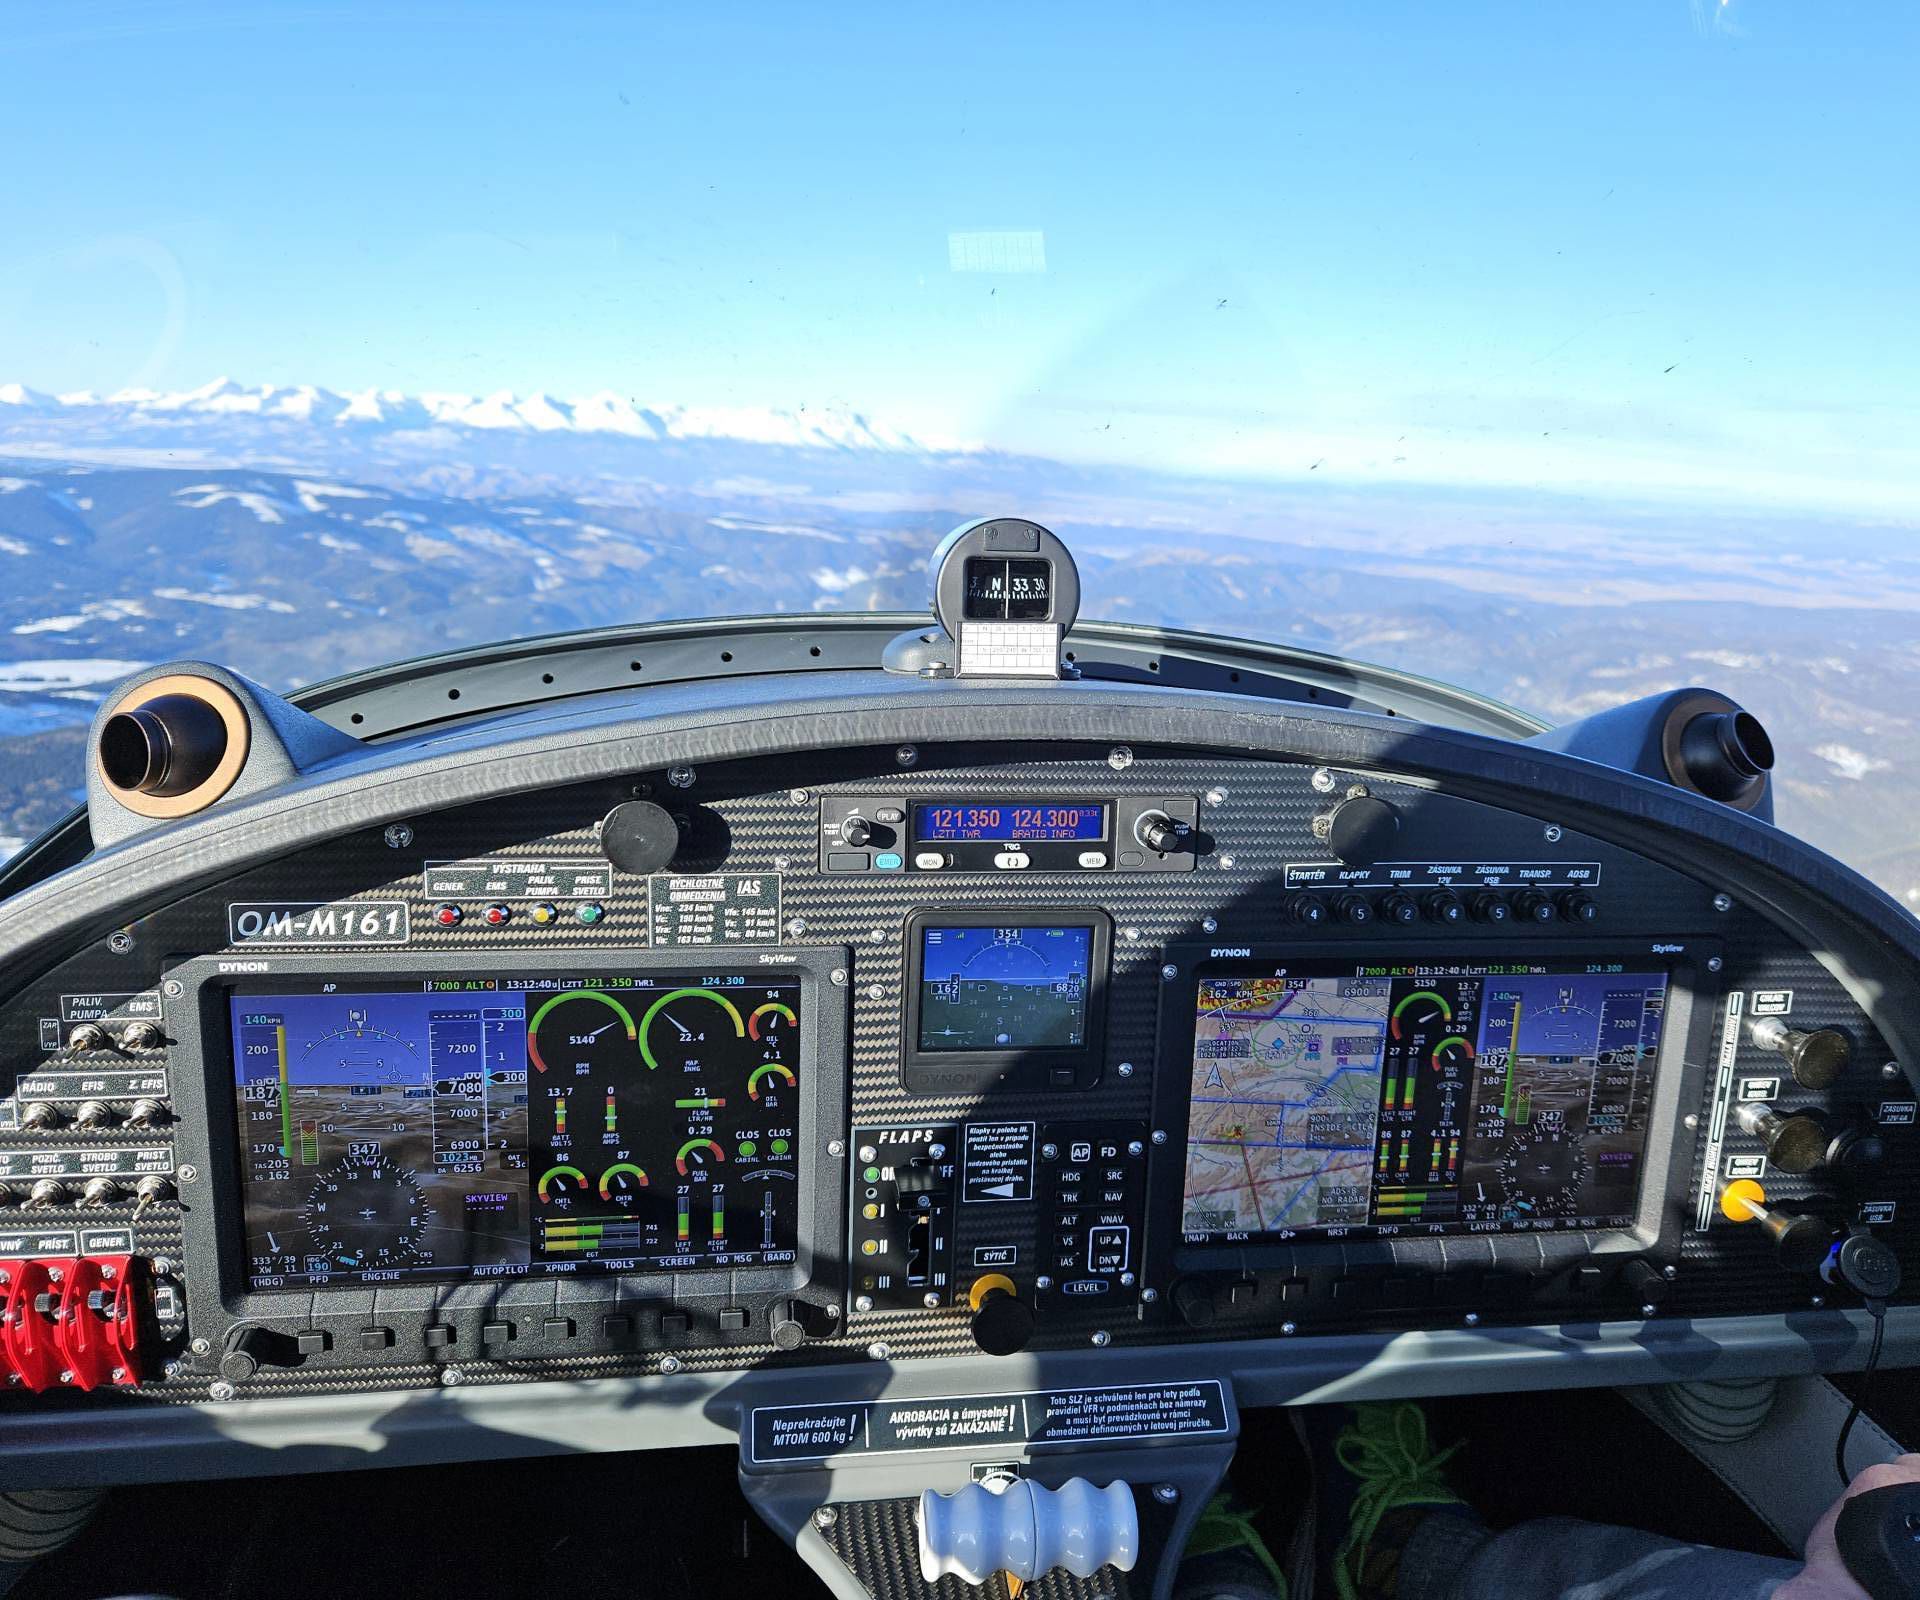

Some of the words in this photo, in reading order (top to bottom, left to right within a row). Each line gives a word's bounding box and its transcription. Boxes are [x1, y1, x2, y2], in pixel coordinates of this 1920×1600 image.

[992, 578, 1001, 590] N
[1013, 579, 1029, 591] 33
[1033, 578, 1045, 591] 30
[881, 813, 899, 821] PLAY
[932, 809, 1000, 827] 121.350
[1012, 809, 1079, 827] 124.300
[932, 830, 957, 839] LZTT
[960, 830, 981, 839] TWR
[1012, 830, 1047, 839] BRATIS
[1051, 830, 1076, 838] INFO
[493, 863, 545, 873] VÝSTRAHA
[1427, 864, 1462, 874] ZÁSUVKA
[1475, 864, 1510, 874] ZÁSUVKA
[1289, 869, 1326, 881] ŠTARTÉR
[1339, 870, 1371, 879] KLAPKY
[1390, 870, 1412, 878] TRIM
[1519, 870, 1552, 878] TRANSP.
[1567, 870, 1590, 878] ADSB
[528, 876, 553, 884] PALIV.
[670, 877, 724, 888] RÝCHLOSTNÉ
[1438, 876, 1452, 884] 12V
[1484, 876, 1500, 884] USB
[433, 882, 465, 891] GENER.
[485, 882, 507, 890] EMS
[525, 887, 558, 896] PUMPA
[572, 887, 605, 896] SVETLO
[737, 880, 761, 894] IAS
[679, 904, 693, 912] 234
[1450, 908, 1457, 918] 4
[1496, 908, 1503, 918] 5
[1542, 908, 1548, 918] 3
[1310, 909, 1318, 919] 4
[1357, 909, 1365, 919] 5
[1404, 909, 1411, 919] 2
[237, 911, 399, 936] OM-M161
[998, 929, 1018, 939] 354
[1210, 949, 1250, 957] DYNON
[1652, 944, 1684, 953] SkyView
[759, 955, 797, 965] SkyView
[219, 962, 268, 972] DYNON
[1365, 967, 1386, 975] 7000
[1488, 966, 1528, 974] 121.350
[1586, 964, 1622, 973] 124.300
[434, 982, 460, 990] 7000
[466, 981, 485, 990] ALT
[583, 978, 632, 988] 121.350
[702, 977, 745, 986] 124.300
[1288, 980, 1304, 988] 354
[323, 984, 336, 992] AP
[72, 997, 102, 1007] PALIV.
[129, 1002, 153, 1012] EMS
[70, 1010, 108, 1019] PUMPA
[245, 1015, 267, 1024] 140
[569, 1036, 595, 1044] 5140
[680, 1033, 705, 1042] 22.4
[246, 1046, 268, 1055] 200
[447, 1045, 477, 1053] 7200
[763, 1051, 781, 1059] 4.1
[22, 1081, 54, 1093] RÁDIO
[81, 1081, 104, 1091] EFIS
[141, 1079, 163, 1089] EFIS
[246, 1087, 274, 1099] 187
[449, 1082, 481, 1093] 7080
[548, 1088, 573, 1096] 13.7
[251, 1111, 273, 1120] 180
[450, 1109, 478, 1118] 7000
[688, 1126, 713, 1135] 0.29
[735, 1131, 760, 1139] CLOS
[768, 1129, 792, 1137] CLOS
[879, 1130, 934, 1144] FLAPS
[352, 1144, 377, 1155] 347
[451, 1141, 479, 1149] 6900
[1073, 1148, 1089, 1158] AP
[1101, 1147, 1117, 1157] FD
[80, 1153, 117, 1162] STROBO
[556, 1154, 569, 1162] 86
[617, 1151, 630, 1159] 87
[31, 1165, 64, 1174] SVETLO
[81, 1163, 117, 1173] SVETLO
[135, 1161, 169, 1172] SVETLO
[267, 1160, 289, 1169] 205
[453, 1164, 482, 1173] 6256
[269, 1171, 290, 1180] 162
[1062, 1173, 1080, 1182] HDG
[1107, 1171, 1123, 1180] SRC
[465, 1195, 508, 1203] SKYVIEW
[1062, 1194, 1078, 1203] TRK
[1104, 1192, 1123, 1201] NAV
[1062, 1216, 1077, 1225] ALT
[1101, 1215, 1124, 1224] VNAV
[1227, 1232, 1249, 1240] BACK
[1378, 1226, 1399, 1234] INFO
[38, 1238, 68, 1250] PRÍST.
[89, 1238, 125, 1248] GENER.
[1063, 1237, 1073, 1246] VS
[1100, 1236, 1111, 1245] UP
[984, 1249, 1009, 1261] SÝTIČ
[1060, 1257, 1074, 1266] IAS
[1099, 1256, 1111, 1265] DN
[254, 1277, 284, 1287] (HDG)
[309, 1275, 329, 1284] PFD
[362, 1272, 400, 1281] ENGINE
[474, 1266, 529, 1276] AUTOPILOT
[546, 1264, 576, 1272] XPNDR
[605, 1261, 635, 1269] TOOLS
[659, 1258, 696, 1267] SCREEN
[716, 1255, 728, 1263] NO
[734, 1254, 752, 1263] MSG
[763, 1252, 796, 1262] (BARO)
[1073, 1283, 1099, 1292] LEVEL
[1050, 1396, 1067, 1405] Toto
[1068, 1394, 1083, 1404] SLZ
[1094, 1392, 1132, 1403] schválené
[889, 1408, 950, 1424] AKROBACIA
[952, 1411, 959, 1420] a
[961, 1404, 1009, 1421] úmyselné
[1046, 1405, 1081, 1418] pravidiel
[1083, 1404, 1098, 1414] VFR
[772, 1416, 846, 1433] Neprekračujte
[896, 1424, 933, 1440] vývrtky
[935, 1423, 947, 1436] sú
[949, 1417, 1006, 1435] ZAKÁZANÉ
[773, 1432, 810, 1446] MTOM
[812, 1431, 830, 1444] 600
[833, 1431, 845, 1444] kg
